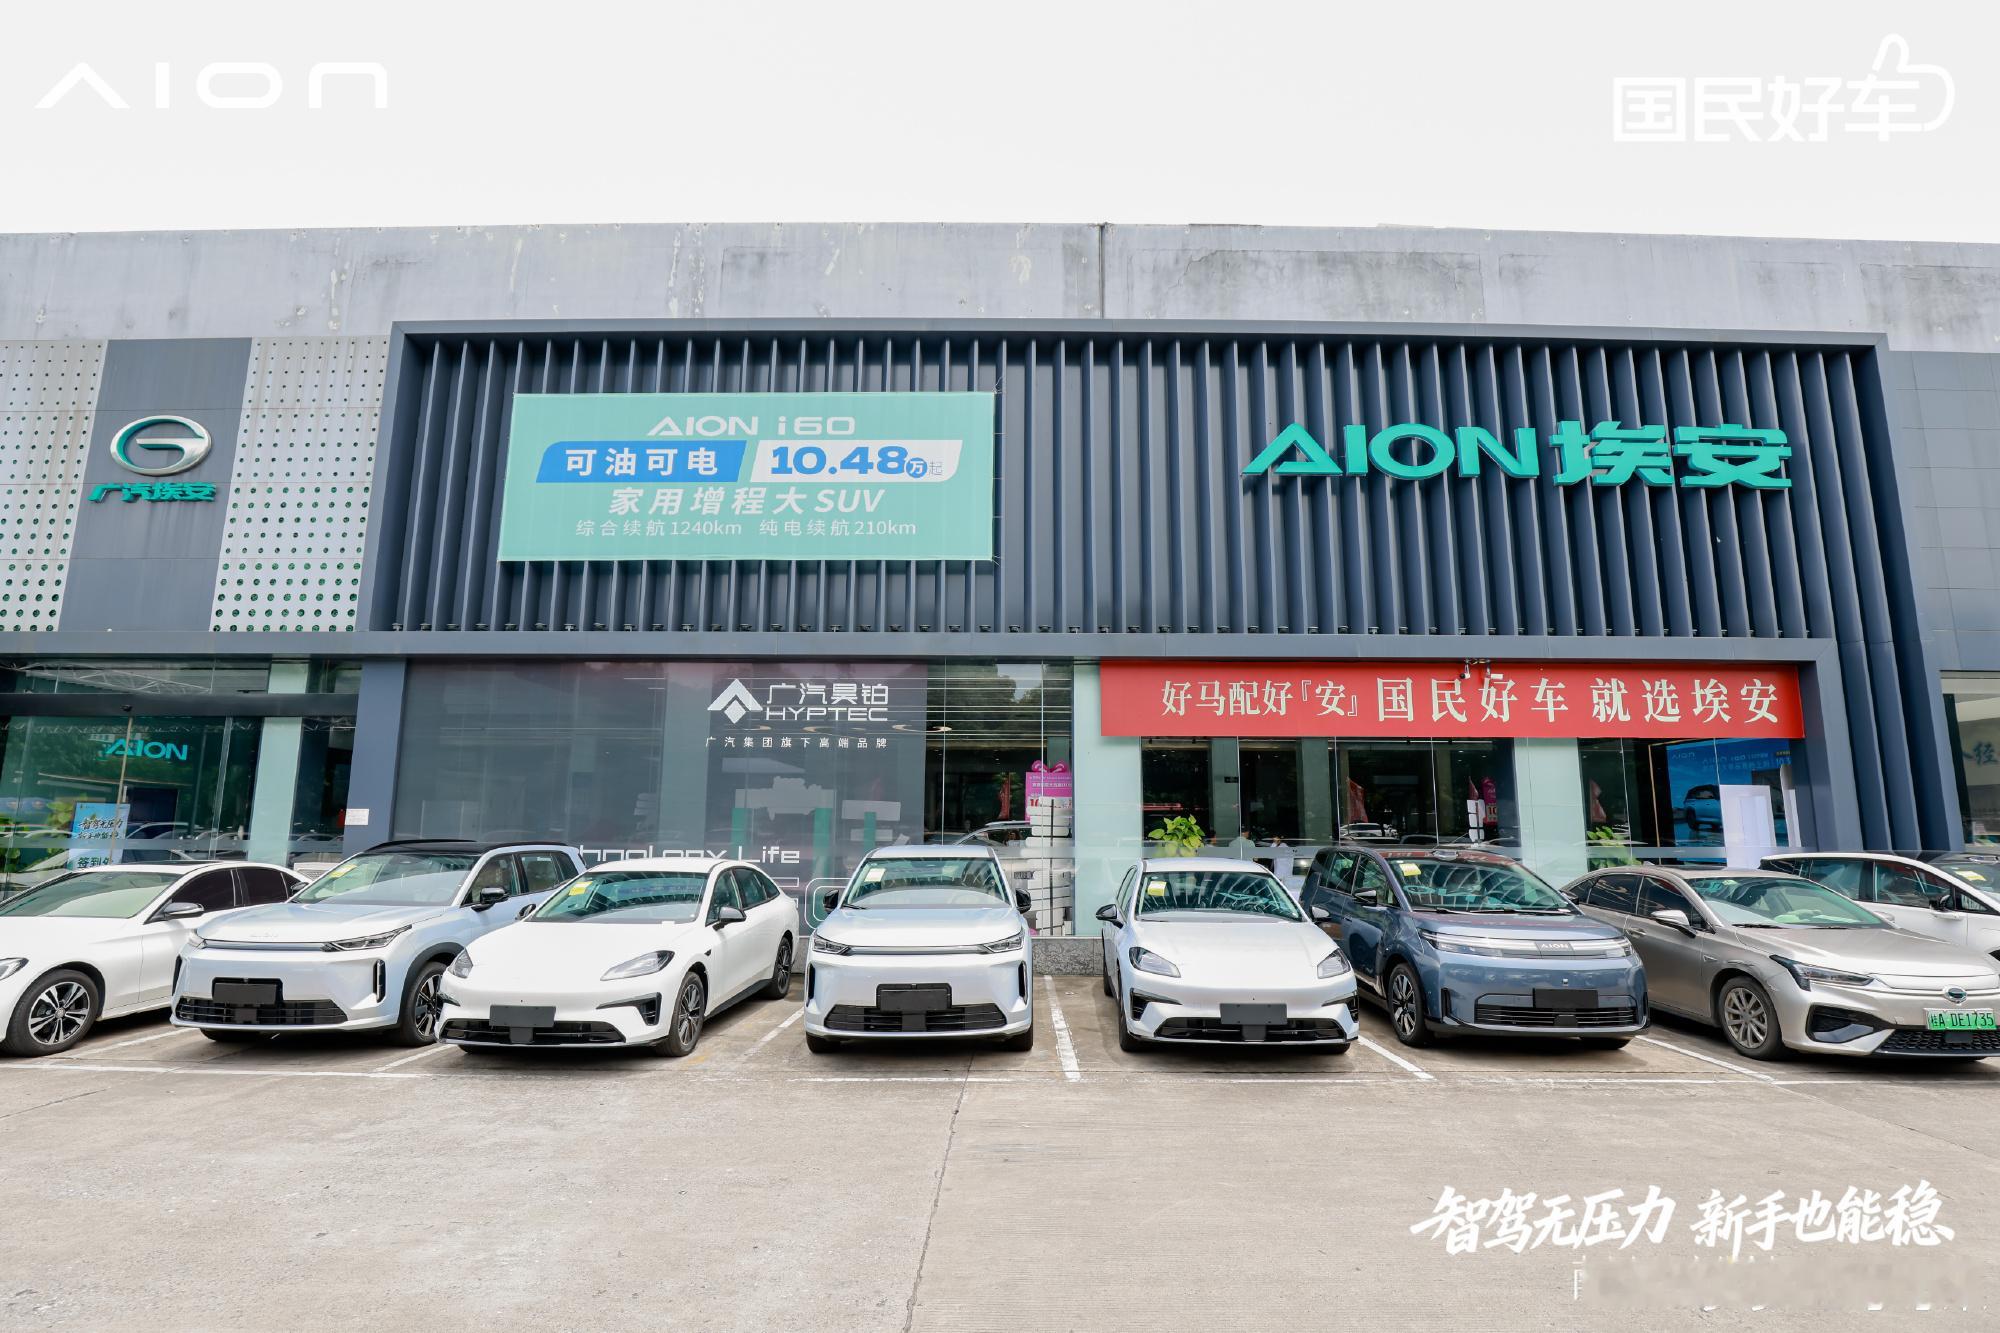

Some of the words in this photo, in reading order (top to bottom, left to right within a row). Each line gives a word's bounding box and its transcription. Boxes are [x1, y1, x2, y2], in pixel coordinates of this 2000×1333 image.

[646, 416, 758, 436] AION
[777, 416, 856, 436] i60
[565, 447, 719, 476] 可油可电
[1240, 421, 1540, 481] AION
[1549, 420, 1793, 489] 埃安
[88, 482, 217, 503] 广汽埃安
[766, 683, 889, 705] 广汽昊铂
[1376, 677, 1569, 723] 国民好车
[1589, 677, 1779, 723] 就选埃安
[765, 707, 888, 722] HYPTEC
[105, 737, 189, 761] AION
[705, 736, 888, 749] 广汽集团旗下高端品牌
[738, 845, 801, 865] Life
